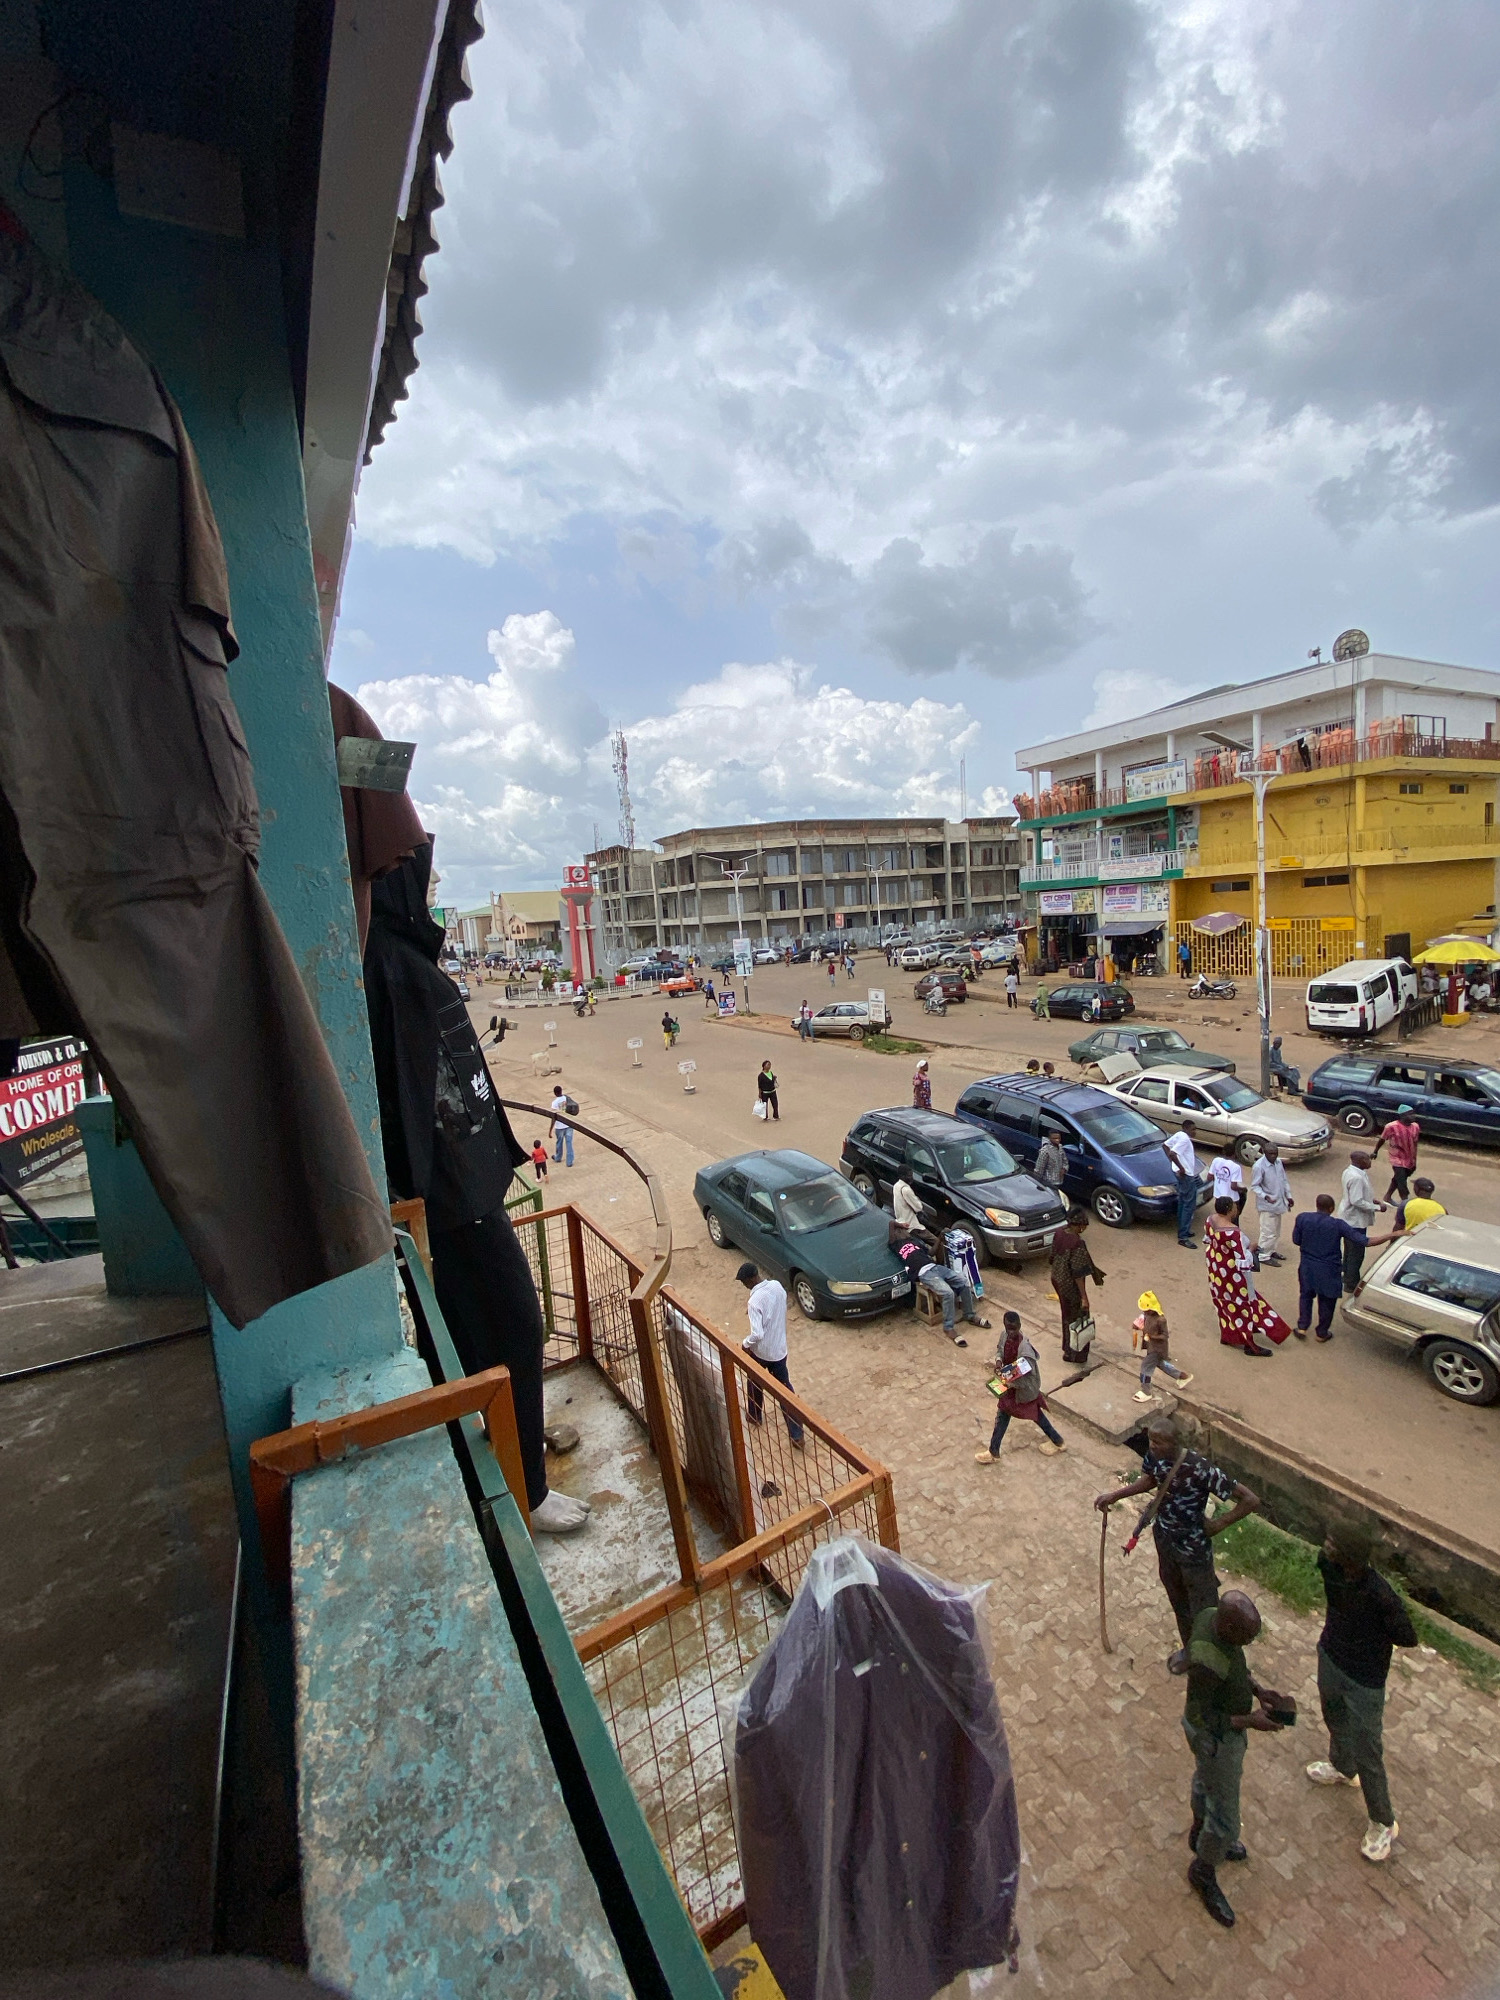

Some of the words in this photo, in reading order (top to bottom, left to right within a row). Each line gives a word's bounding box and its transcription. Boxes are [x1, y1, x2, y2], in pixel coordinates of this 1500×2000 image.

[1106, 887, 1117, 895] CITY
[18, 1050, 54, 1073] JOHNSON
[55, 1047, 63, 1061] &
[8, 1075, 45, 1095] HOME
[47, 1068, 62, 1083] OF
[21, 1124, 74, 1157] Wholesale
